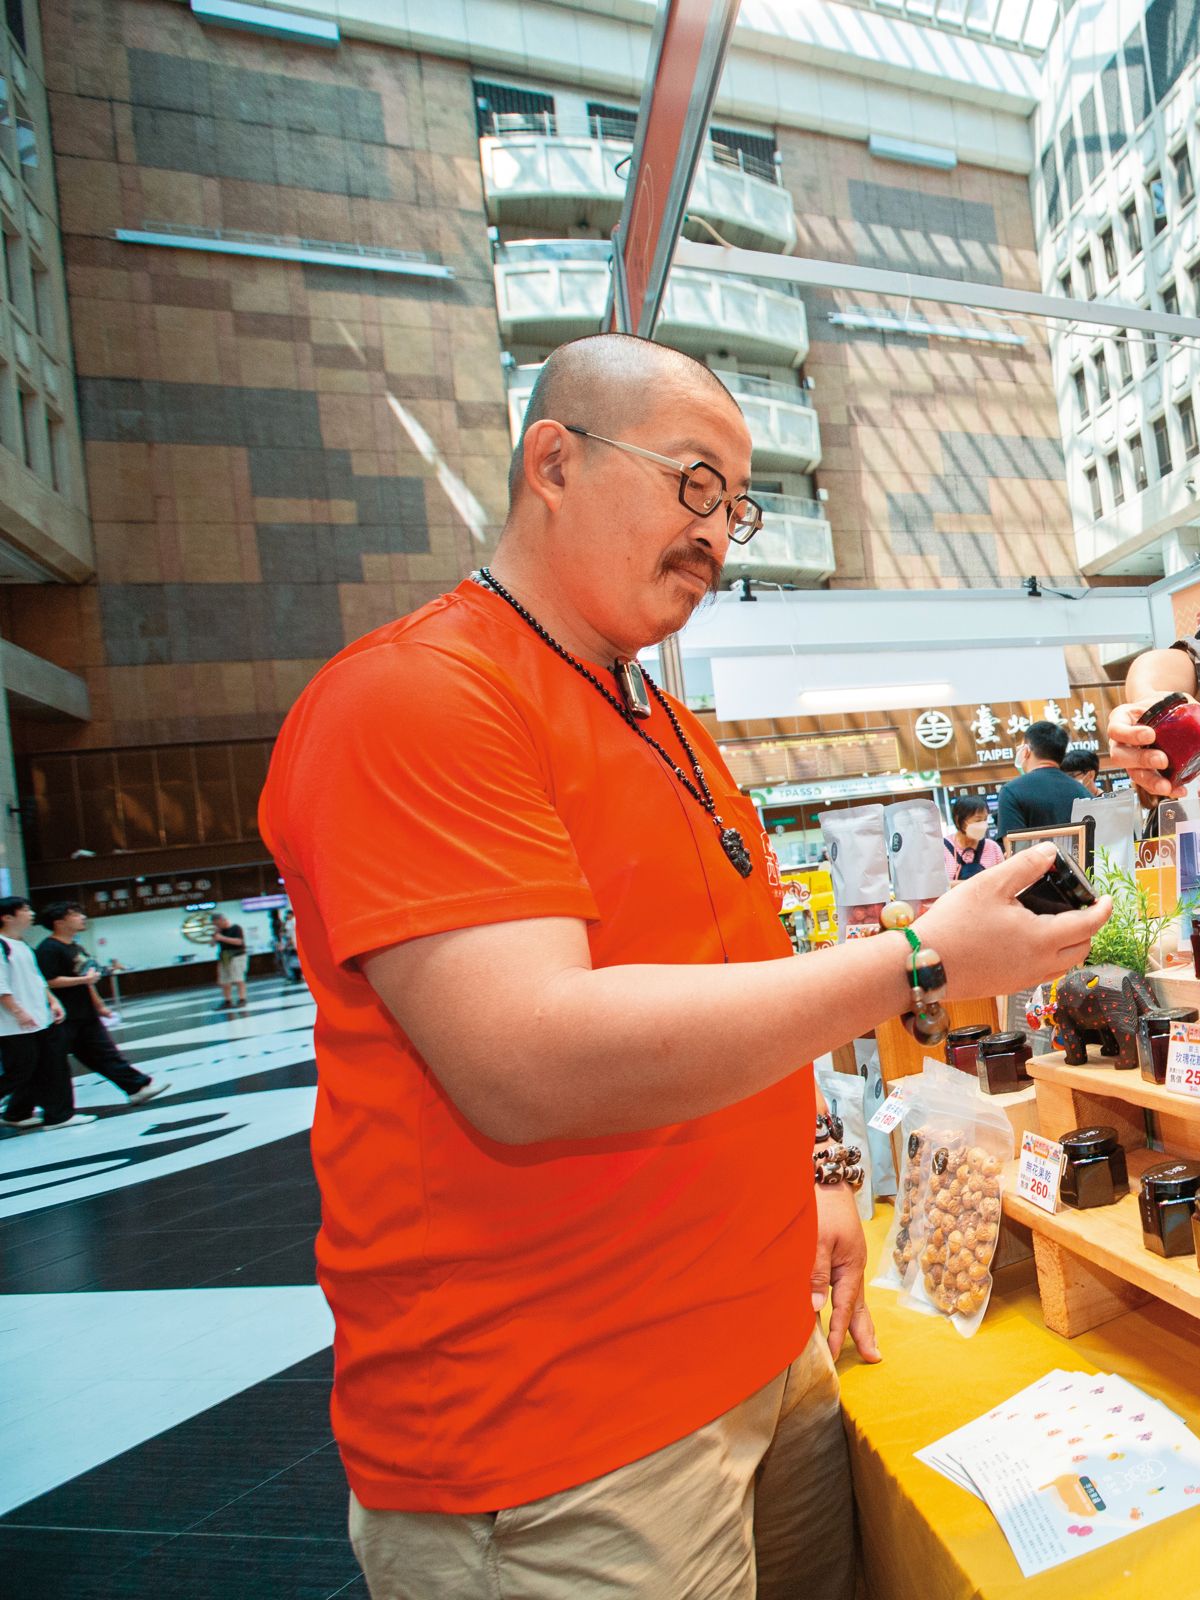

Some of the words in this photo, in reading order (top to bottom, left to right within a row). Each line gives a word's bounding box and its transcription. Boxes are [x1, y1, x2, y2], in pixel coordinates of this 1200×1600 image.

[976, 747, 1014, 762] TAIPEI
[779, 787, 813, 798] TPASS
[1030, 1178, 1049, 1199] 260
